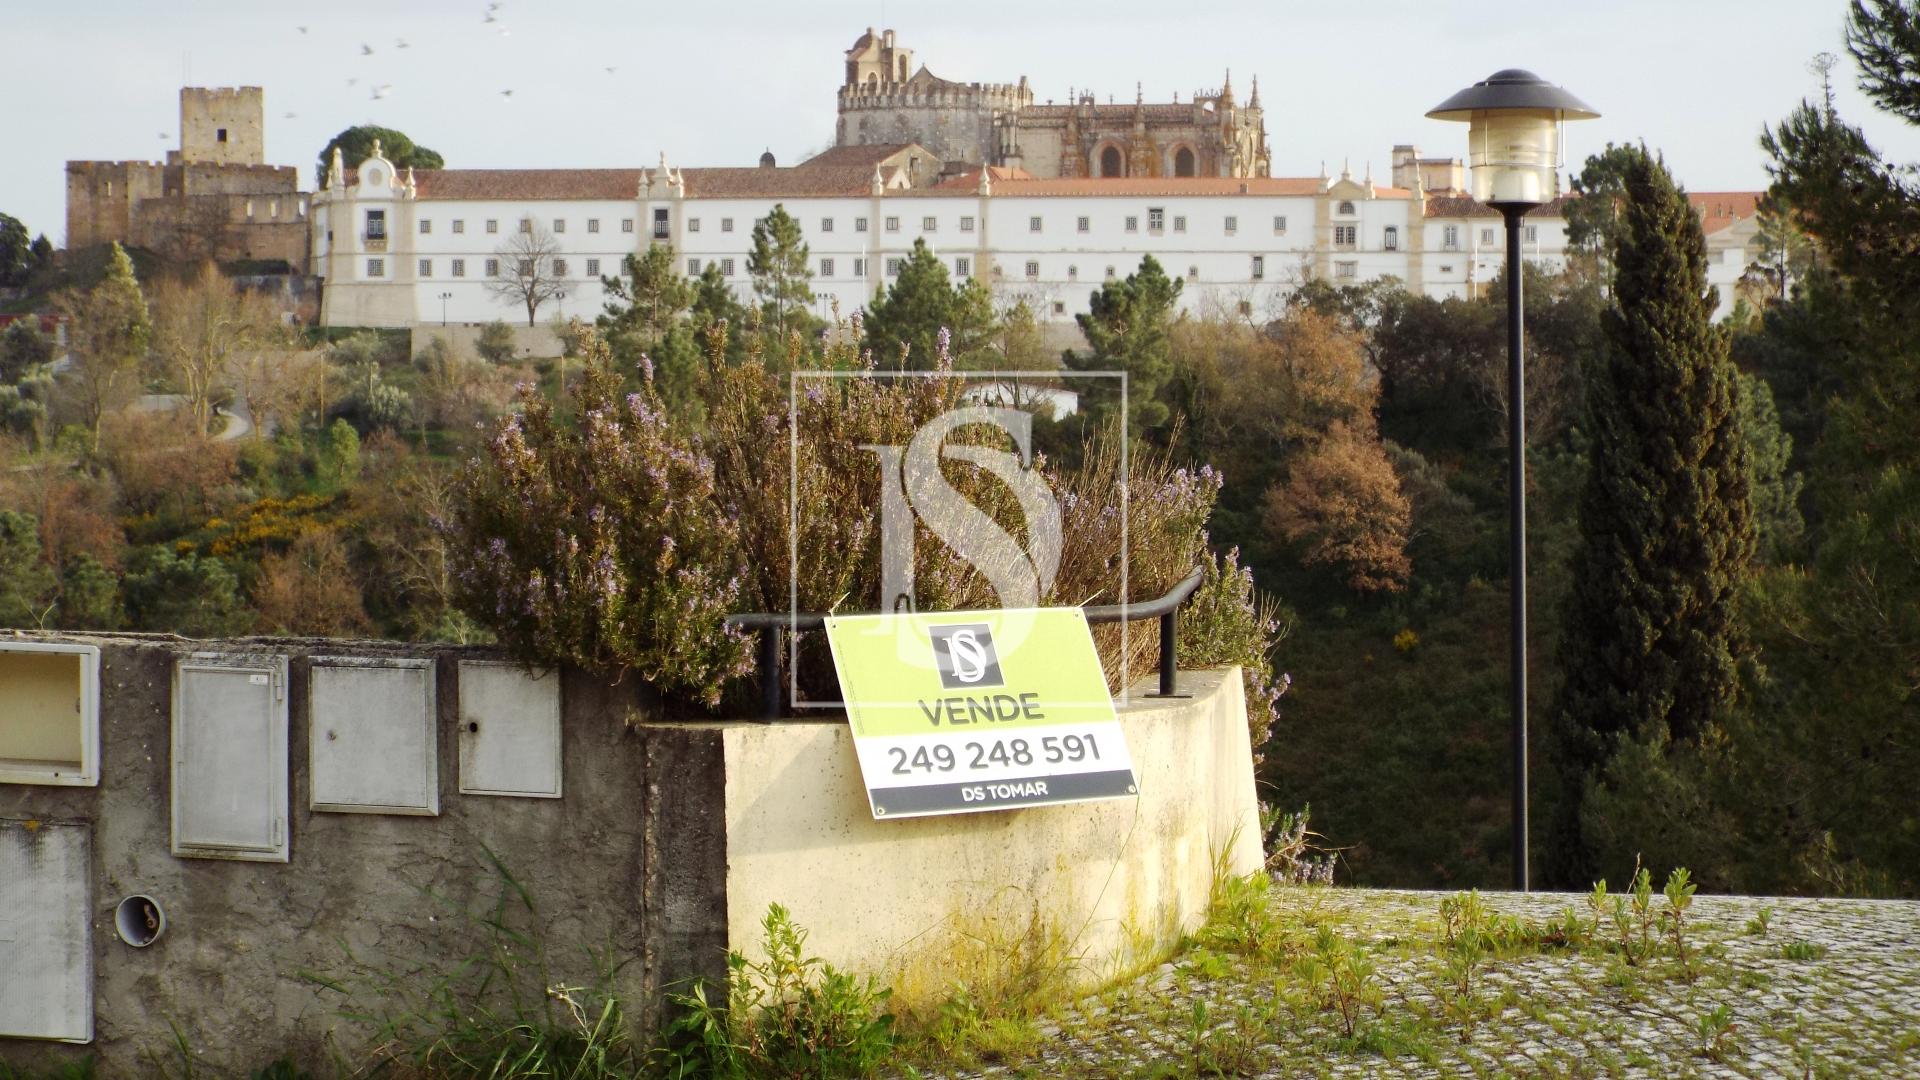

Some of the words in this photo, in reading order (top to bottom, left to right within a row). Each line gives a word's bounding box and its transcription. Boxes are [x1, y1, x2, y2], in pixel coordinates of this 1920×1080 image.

[918, 692, 1045, 726] VENDE
[887, 743, 956, 776] 249
[965, 738, 1034, 770] 248
[1041, 733, 1101, 763] 591
[961, 786, 986, 802] DS
[987, 781, 1048, 800] TOMAR
